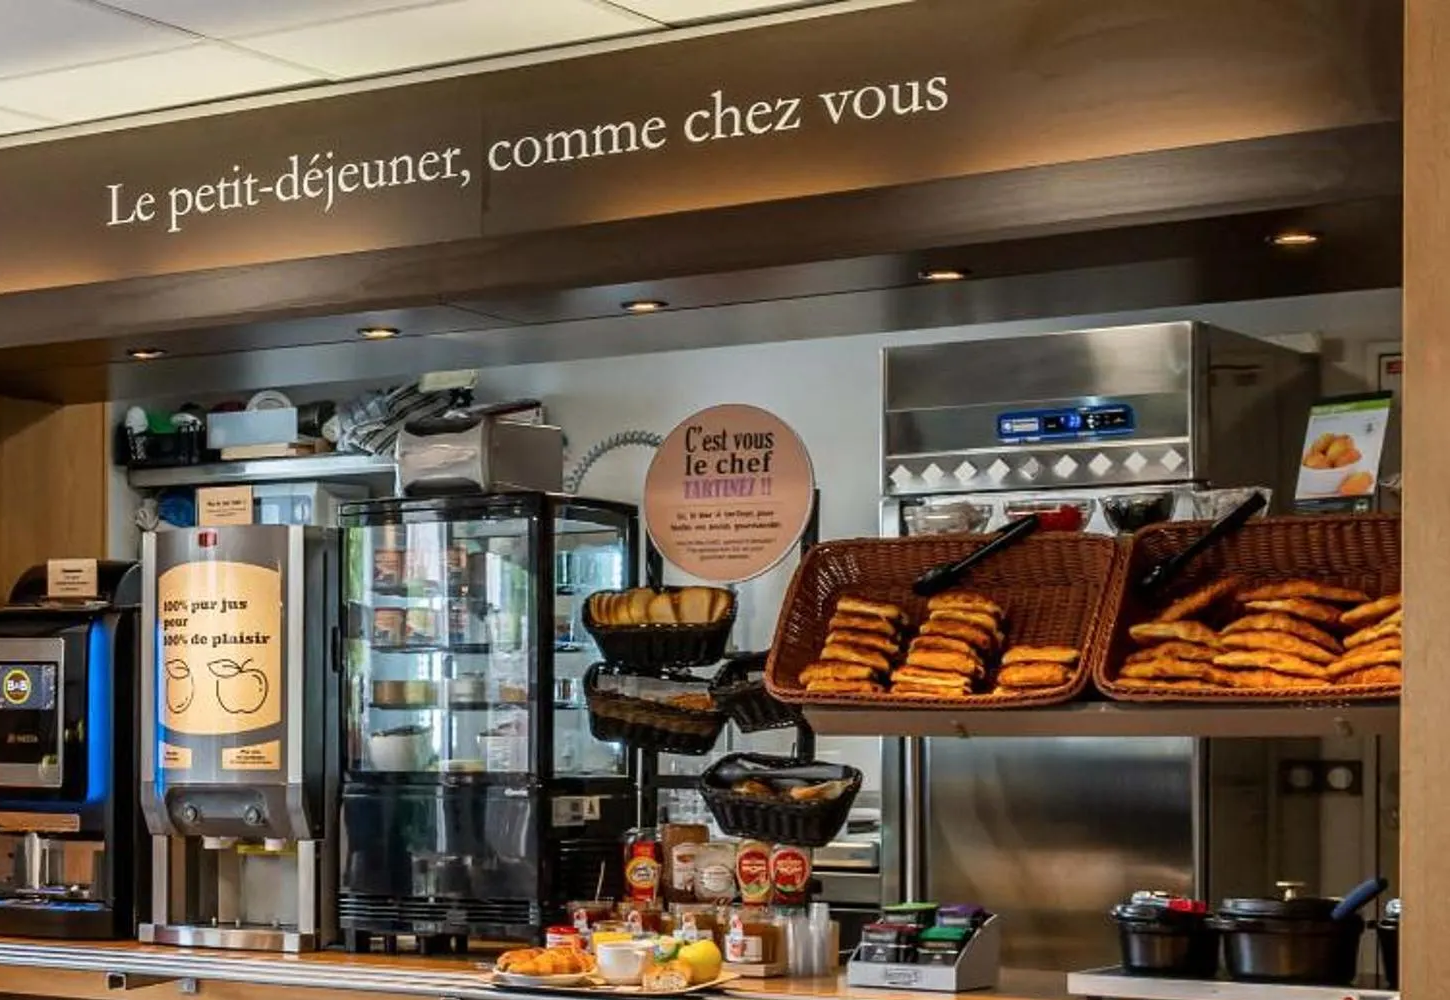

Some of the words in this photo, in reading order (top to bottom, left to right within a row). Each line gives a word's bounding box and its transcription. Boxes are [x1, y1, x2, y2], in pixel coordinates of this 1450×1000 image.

[106, 183, 156, 226] Le
[167, 143, 472, 234] petit-déjeuner,
[487, 117, 667, 173] comme
[684, 90, 803, 143] chez
[819, 76, 949, 125] vous
[685, 426, 727, 453] C'est
[733, 432, 775, 451] vous
[685, 454, 707, 476] le
[716, 451, 773, 474] chef
[683, 478, 755, 499] TARTINEZ
[191, 600, 217, 614] pur
[220, 597, 248, 613] jus
[163, 618, 188, 631] pour
[191, 634, 208, 645] de
[212, 631, 271, 648] plaisir
